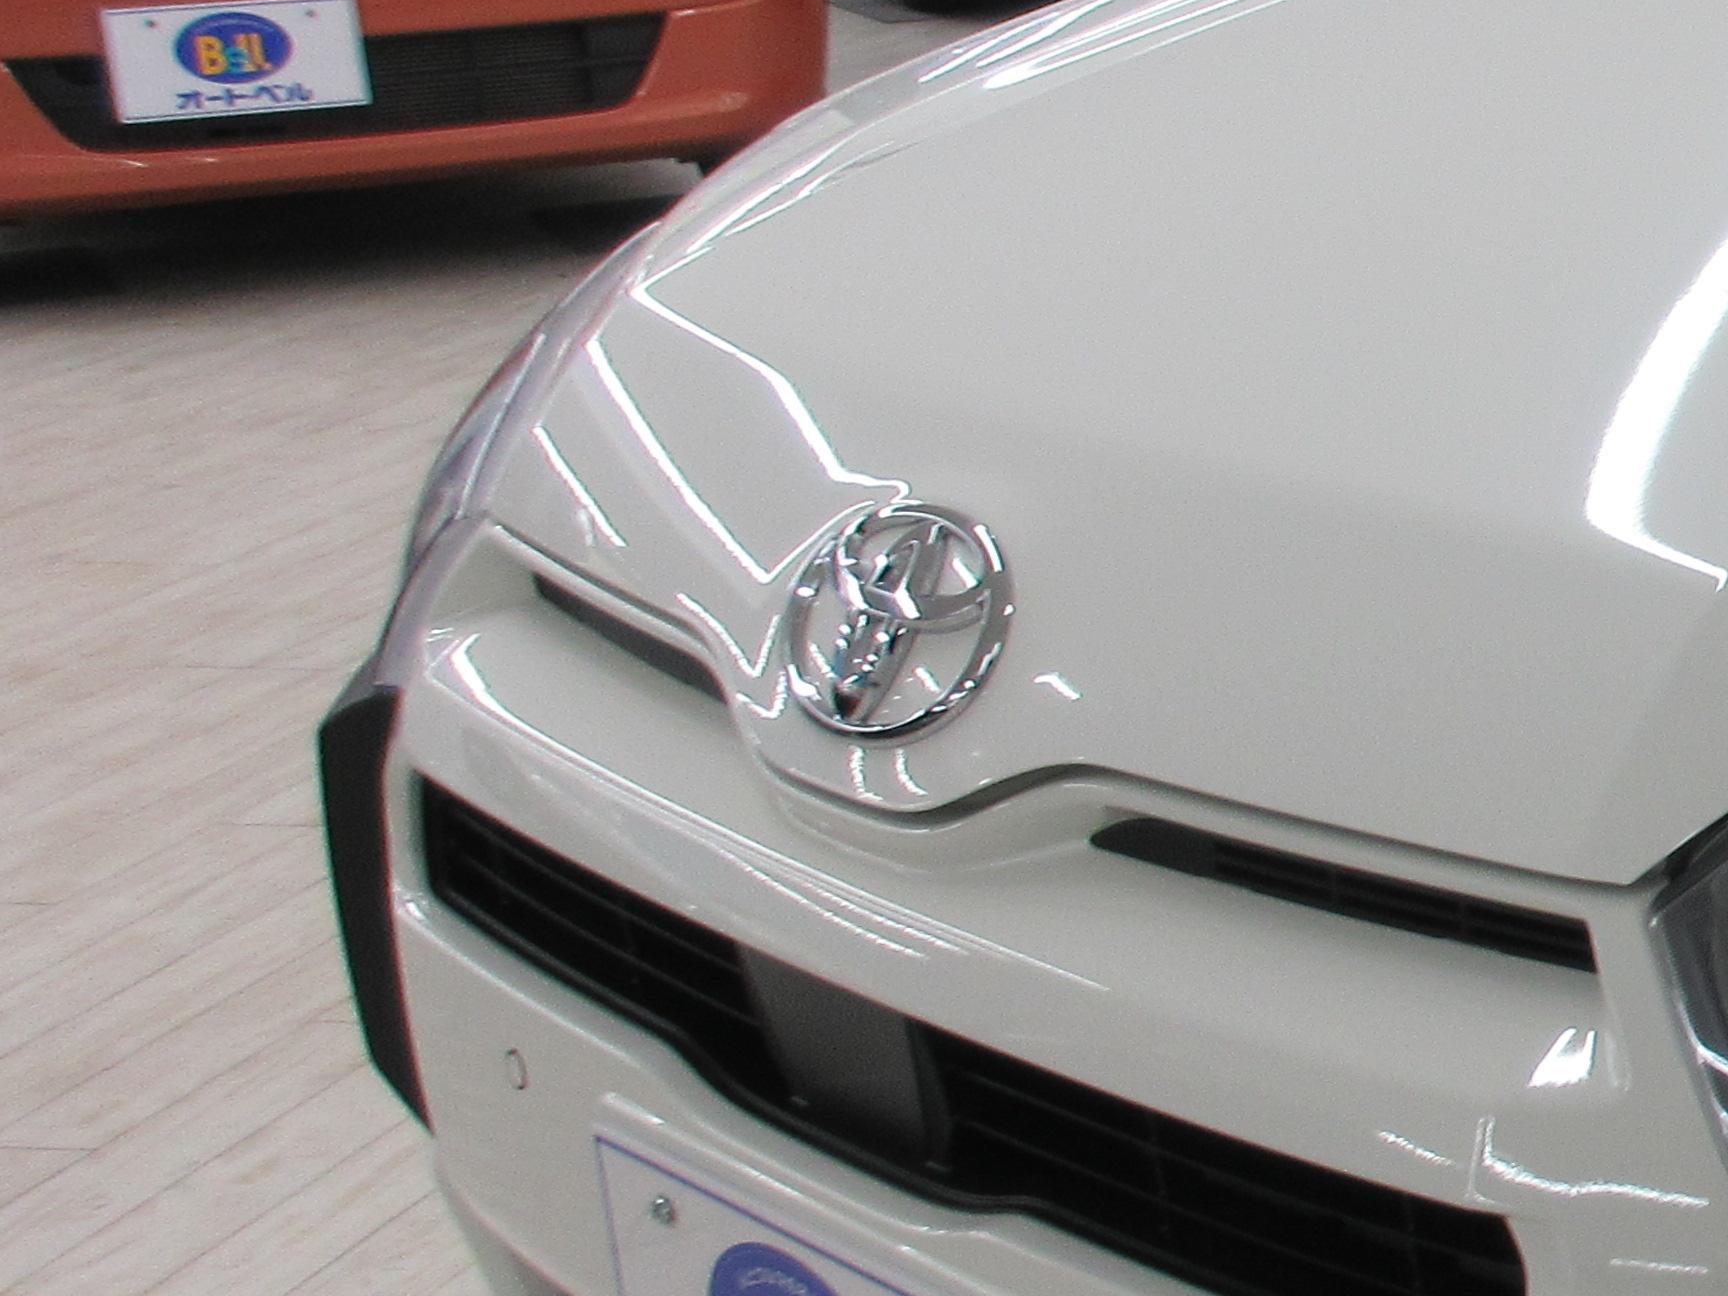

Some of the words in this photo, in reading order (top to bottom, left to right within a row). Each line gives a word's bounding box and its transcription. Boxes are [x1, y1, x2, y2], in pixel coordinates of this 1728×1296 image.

[175, 83, 315, 109] オートベル
